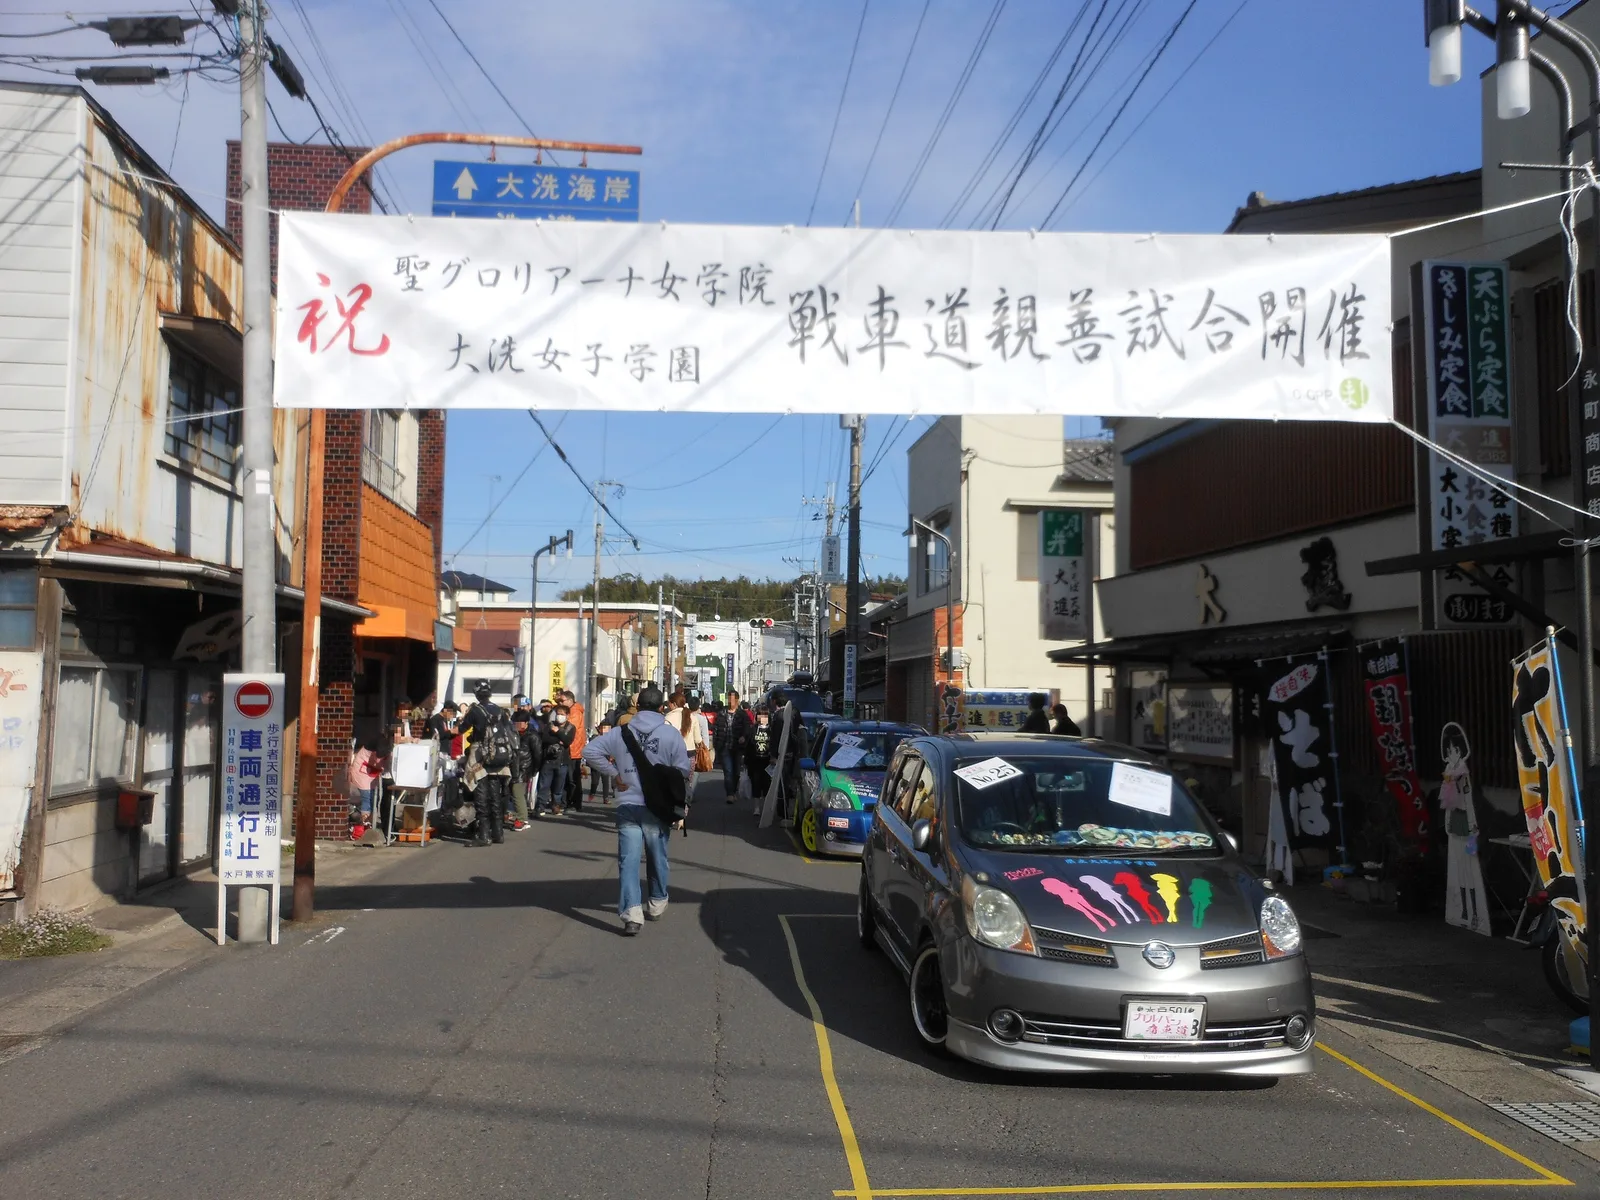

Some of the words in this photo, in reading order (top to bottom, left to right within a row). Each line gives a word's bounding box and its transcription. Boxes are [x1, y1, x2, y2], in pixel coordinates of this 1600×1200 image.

[496, 172, 632, 203] 大洗海岸
[296, 272, 390, 357] 祝
[394, 254, 776, 307] 聖グロリアーナ女学院
[446, 332, 701, 385] 大洗女子学園
[786, 282, 1372, 372] 戦車道親善試合開催
[1473, 271, 1505, 413] 天ぷら定食
[237, 729, 262, 860] 車両通行止
[264, 723, 280, 837] 歩行者天国交通規制
[224, 869, 275, 879] 水戸警察署
